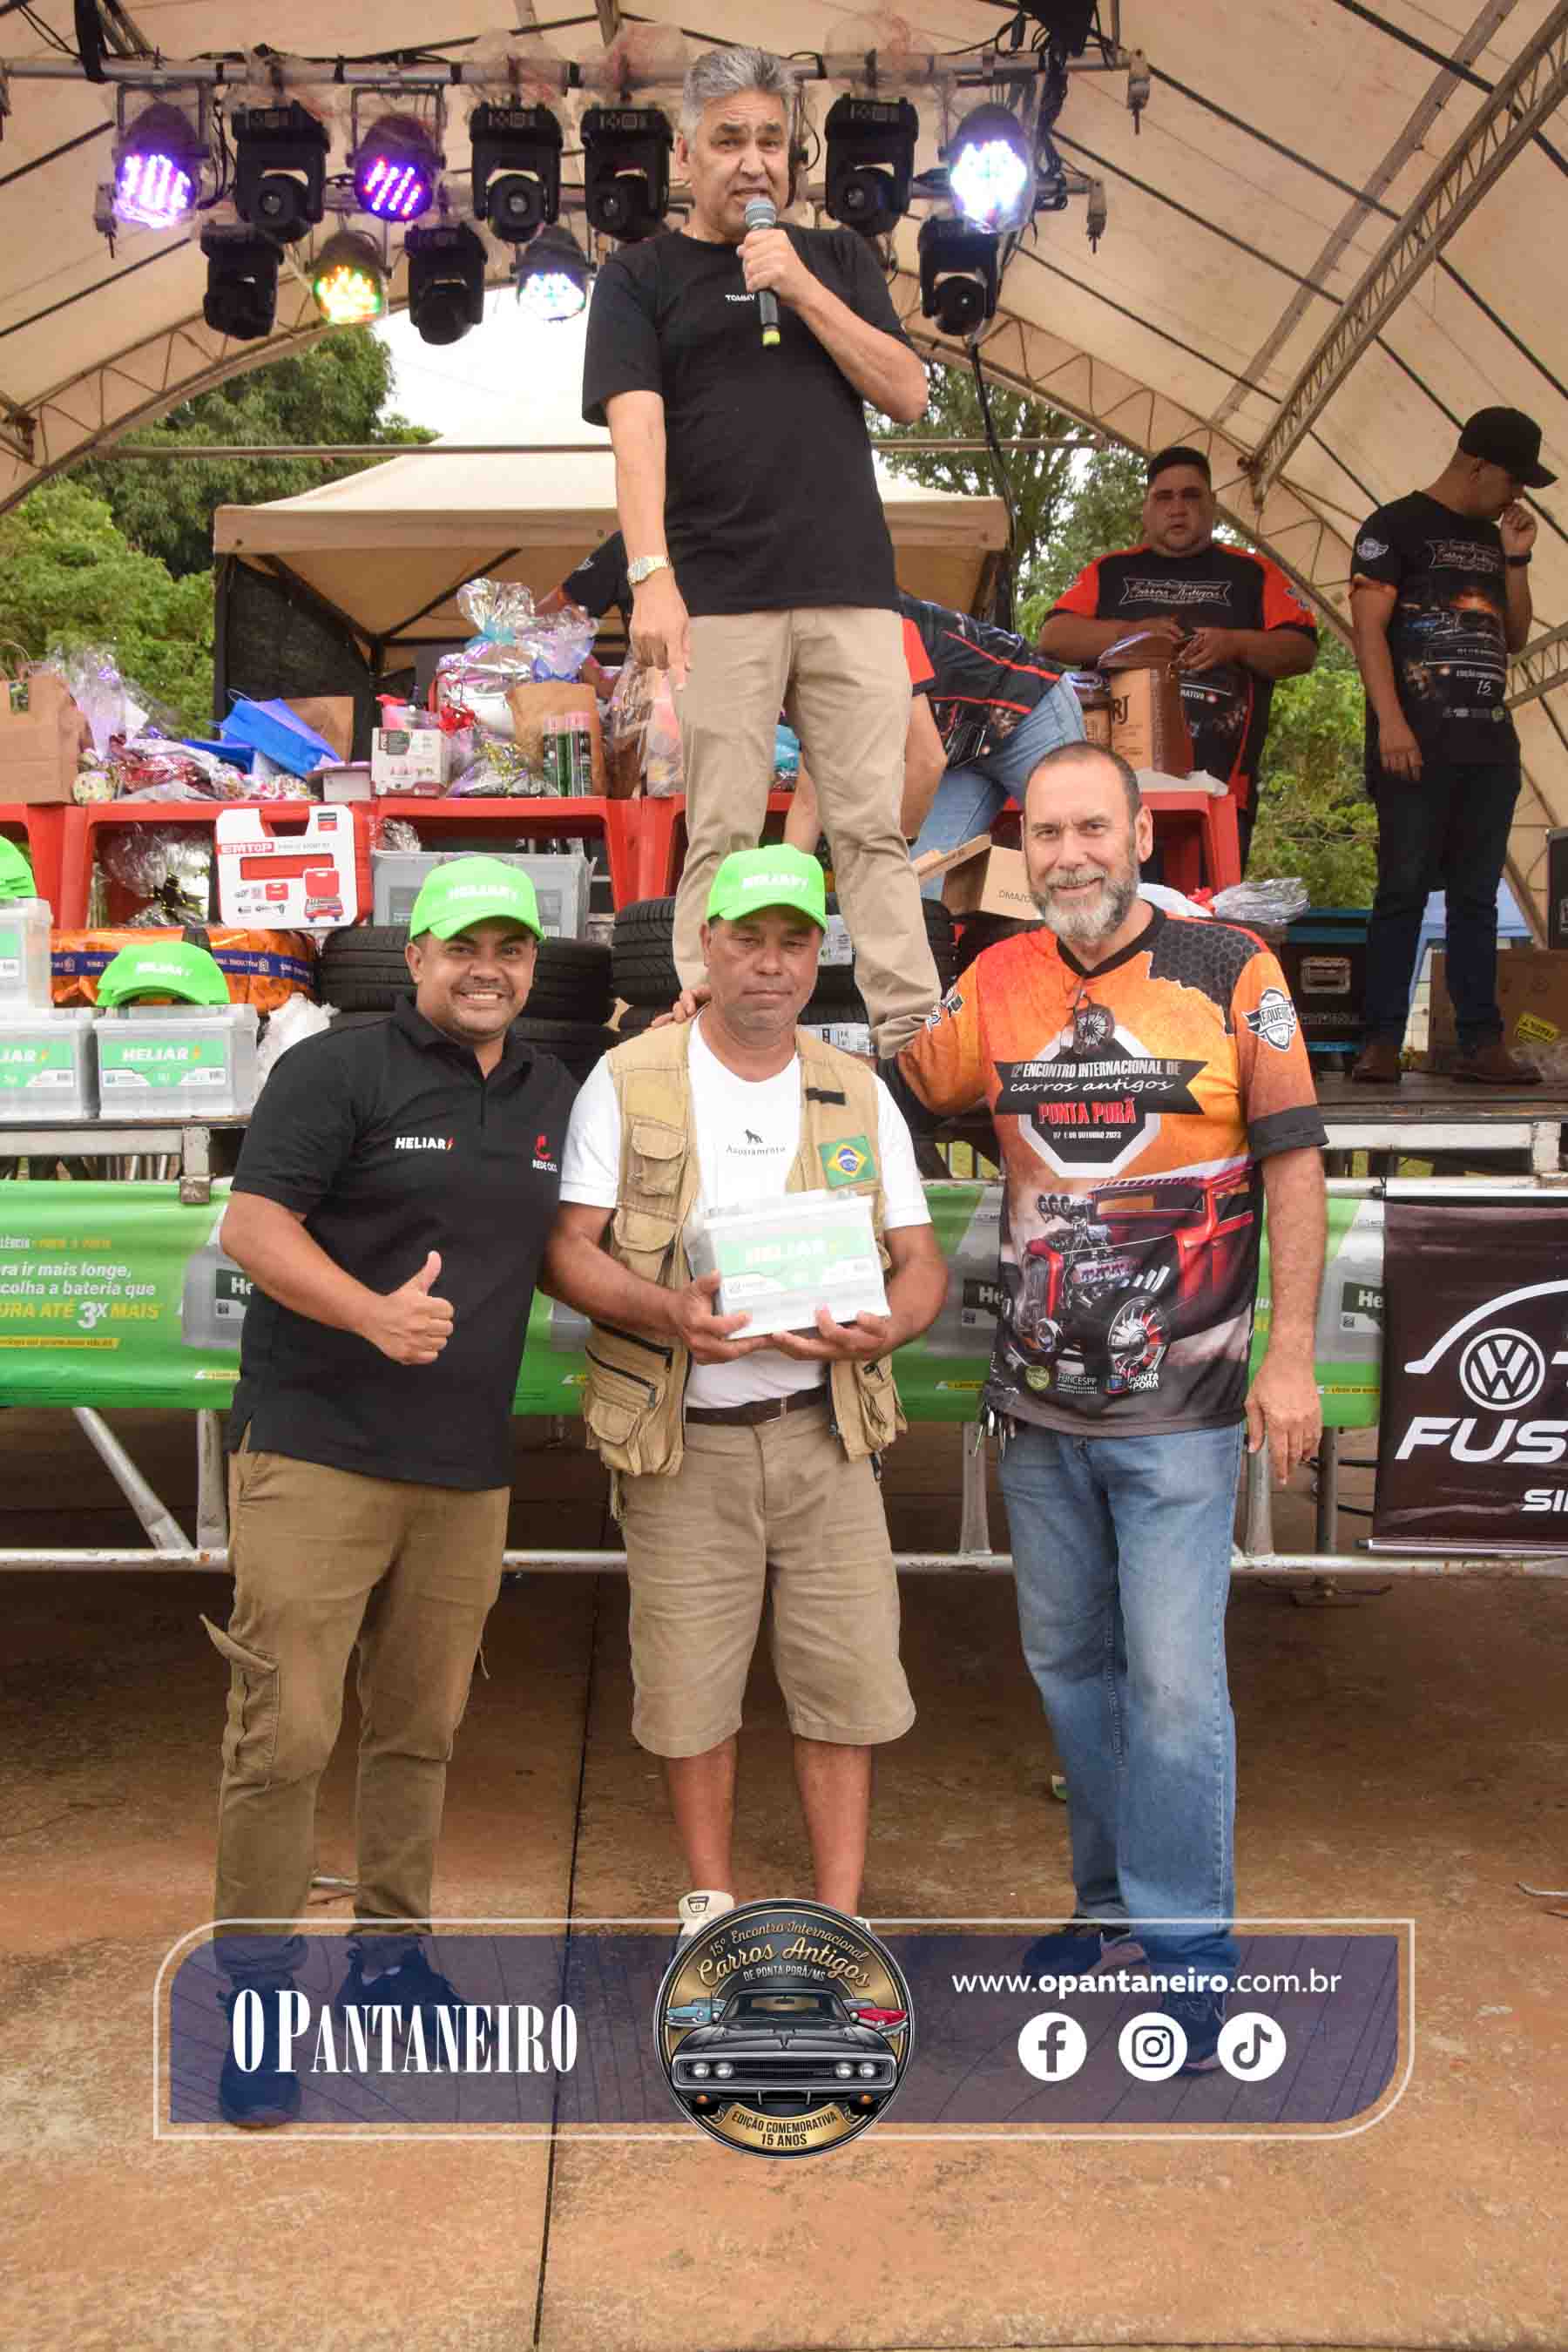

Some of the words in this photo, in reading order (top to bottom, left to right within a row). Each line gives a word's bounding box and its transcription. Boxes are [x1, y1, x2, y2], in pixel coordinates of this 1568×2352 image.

[0, 1048, 37, 1062] IAR
[122, 1046, 189, 1062] HELIAR
[1023, 1063, 1077, 1078] ENCONTRO
[1078, 1059, 1164, 1078] INTERNACIONAL
[1010, 1082, 1079, 1093] carros
[1082, 1077, 1175, 1093] antigos
[395, 1136, 447, 1151] HELIAR
[22, 1261, 35, 1276] ir
[38, 1261, 77, 1276] mais
[49, 1283, 57, 1295] a
[63, 1281, 120, 1296] bateria
[125, 1284, 155, 1299] que
[40, 1296, 75, 1318] ATÉ
